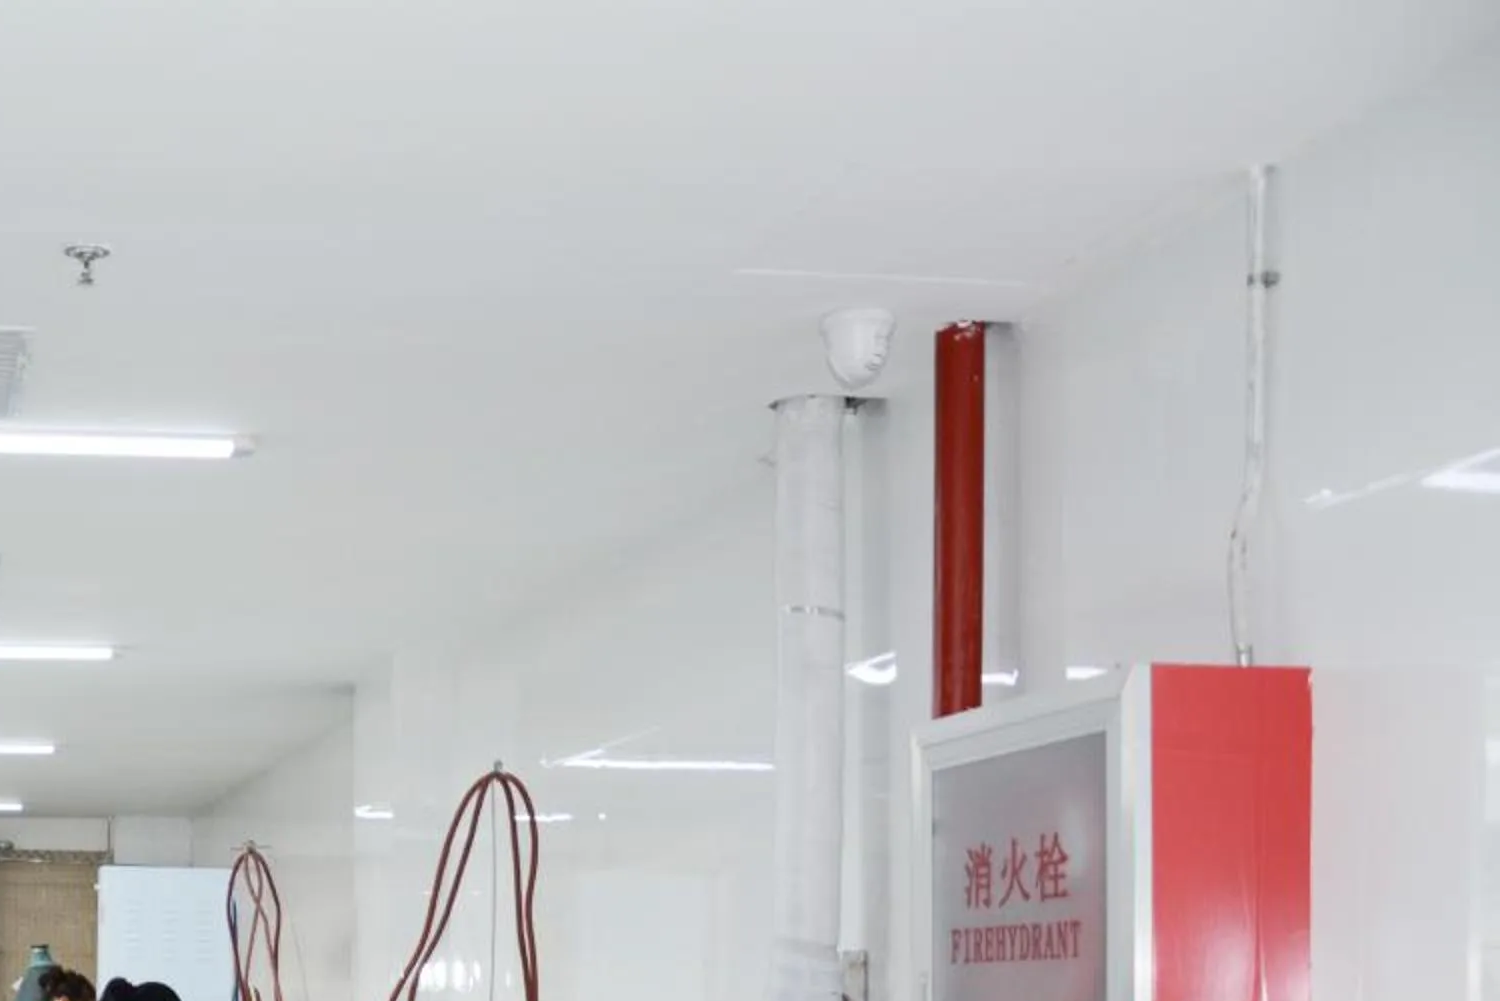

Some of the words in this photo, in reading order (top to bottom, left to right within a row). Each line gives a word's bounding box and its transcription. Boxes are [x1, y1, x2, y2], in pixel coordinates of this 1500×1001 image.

[964, 832, 1069, 909] 消火栓
[950, 920, 1081, 965] FIREHYDRANT
